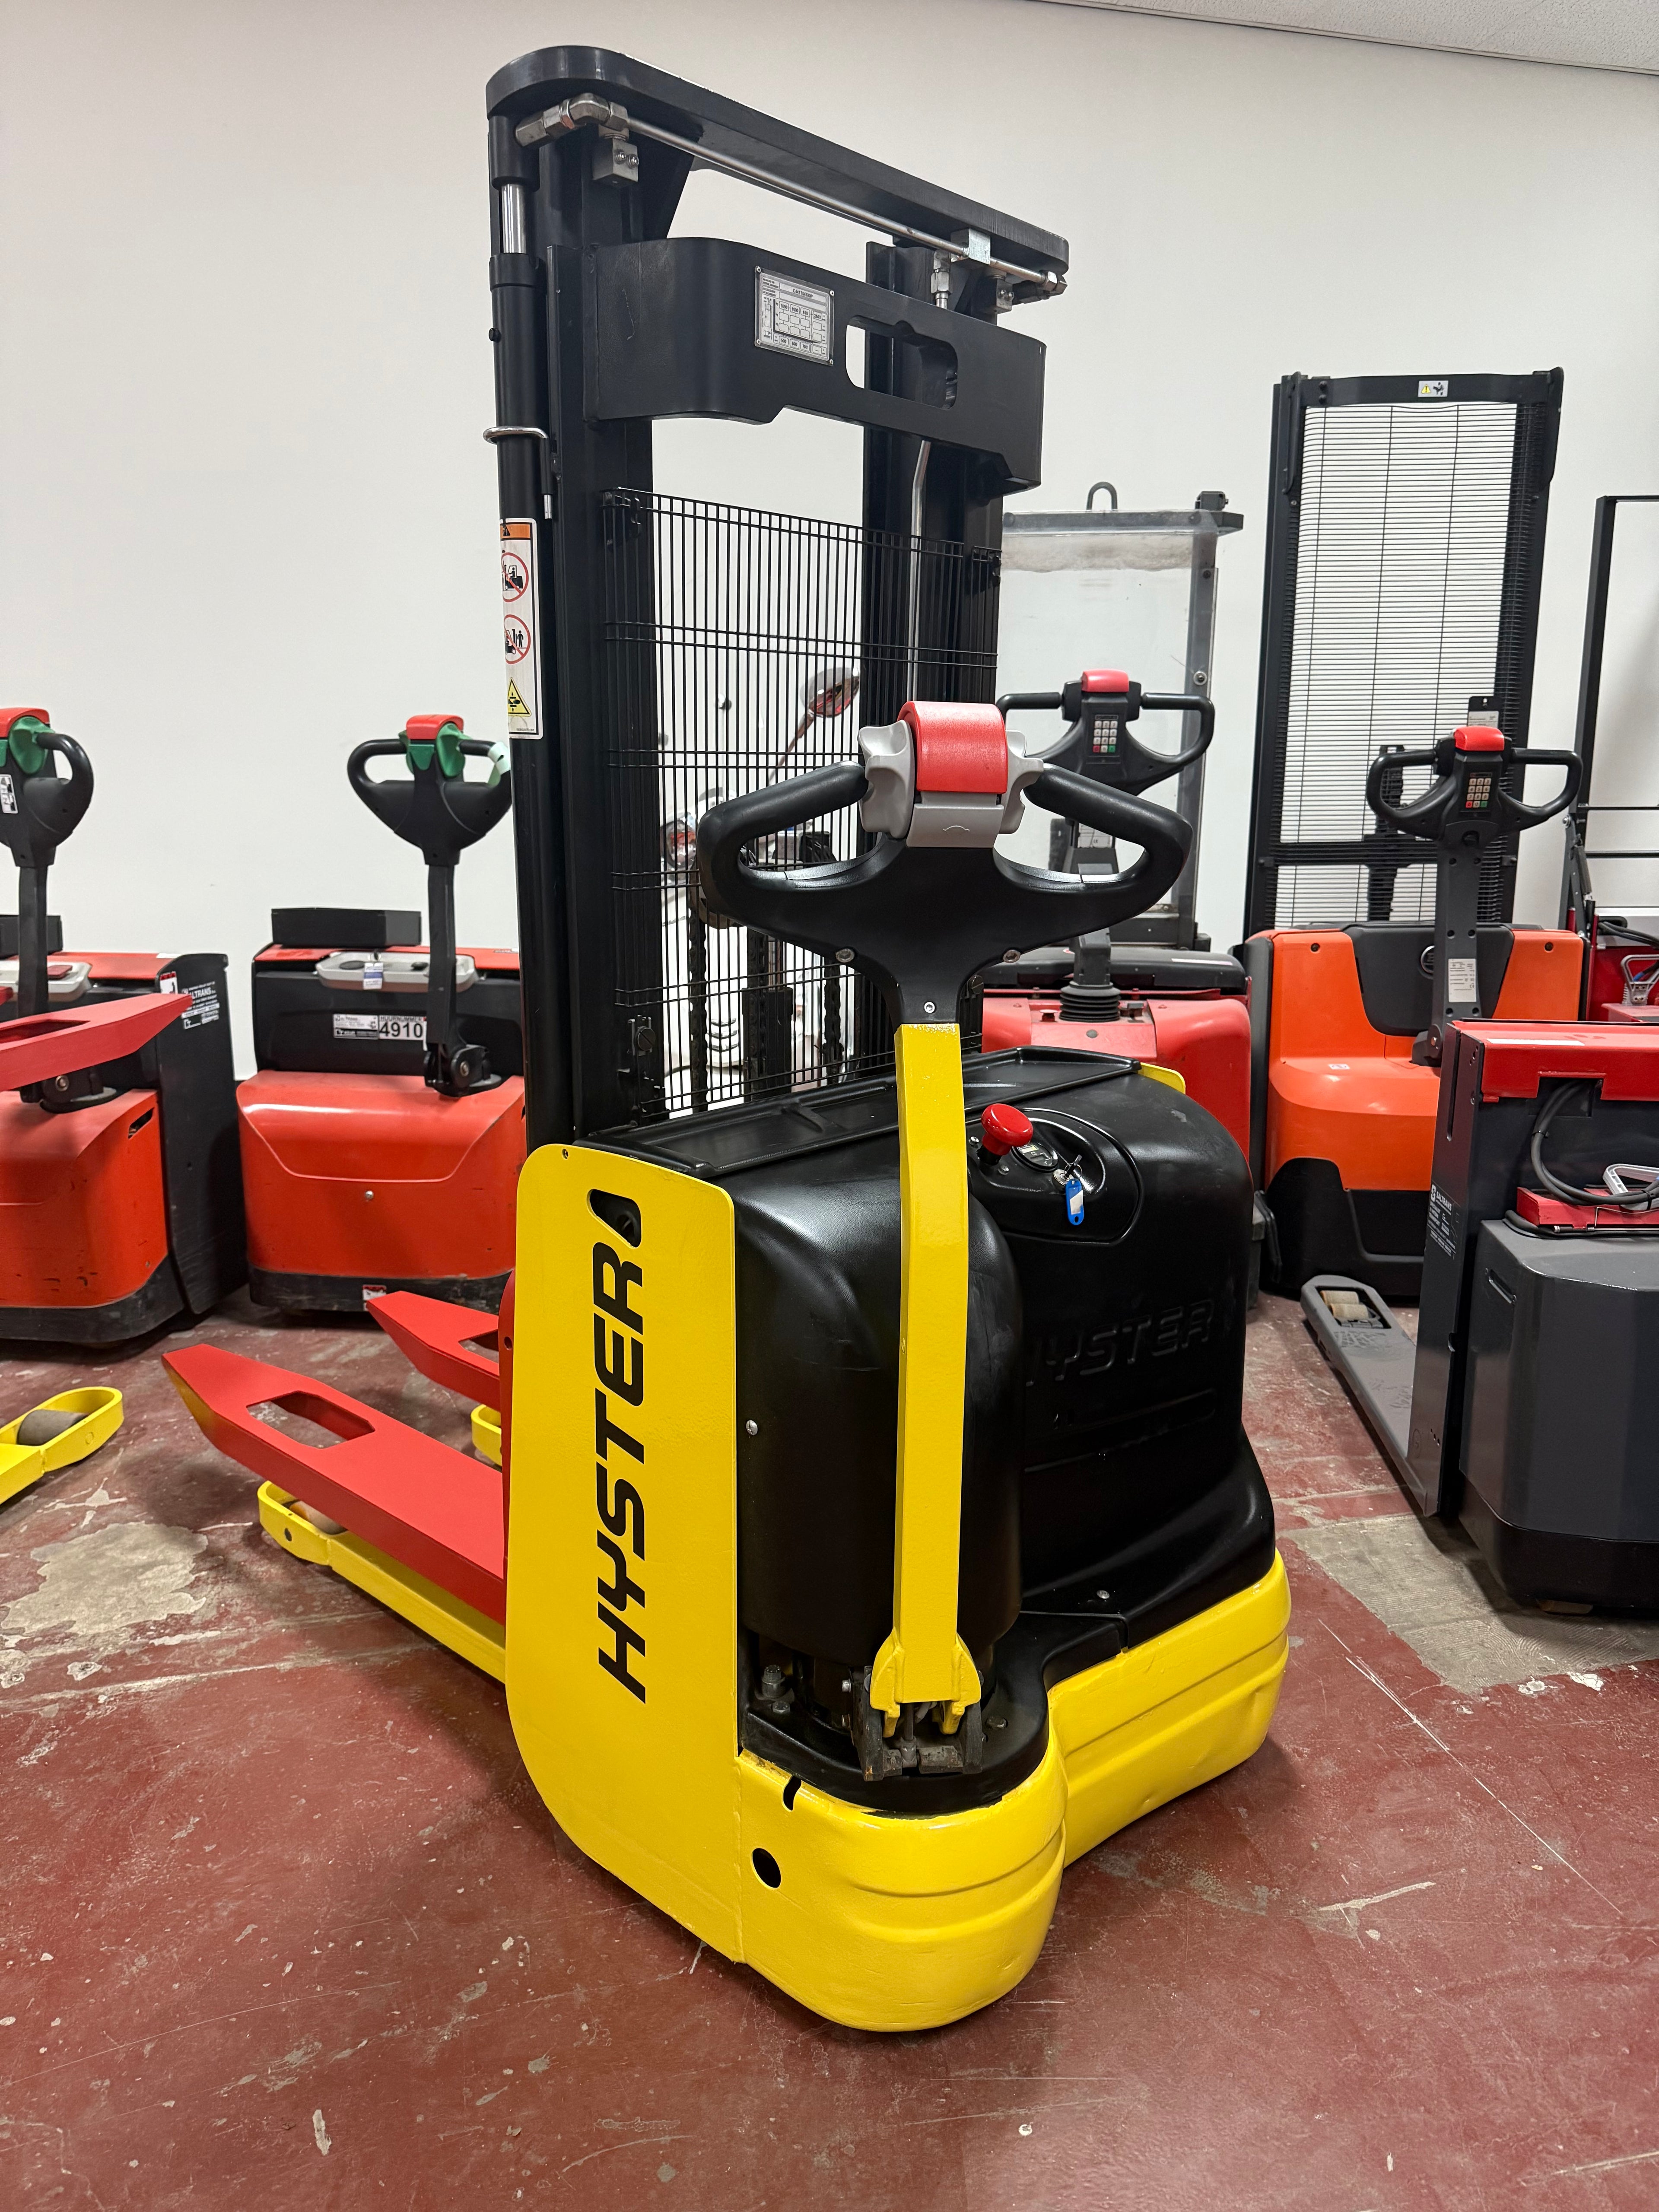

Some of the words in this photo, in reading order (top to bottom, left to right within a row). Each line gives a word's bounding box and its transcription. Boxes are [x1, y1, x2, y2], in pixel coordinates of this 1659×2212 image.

[379, 1021, 423, 1038] 4910
[1436, 1191, 1452, 1211] SALTRANS
[593, 1241, 647, 1704] HYSTER
